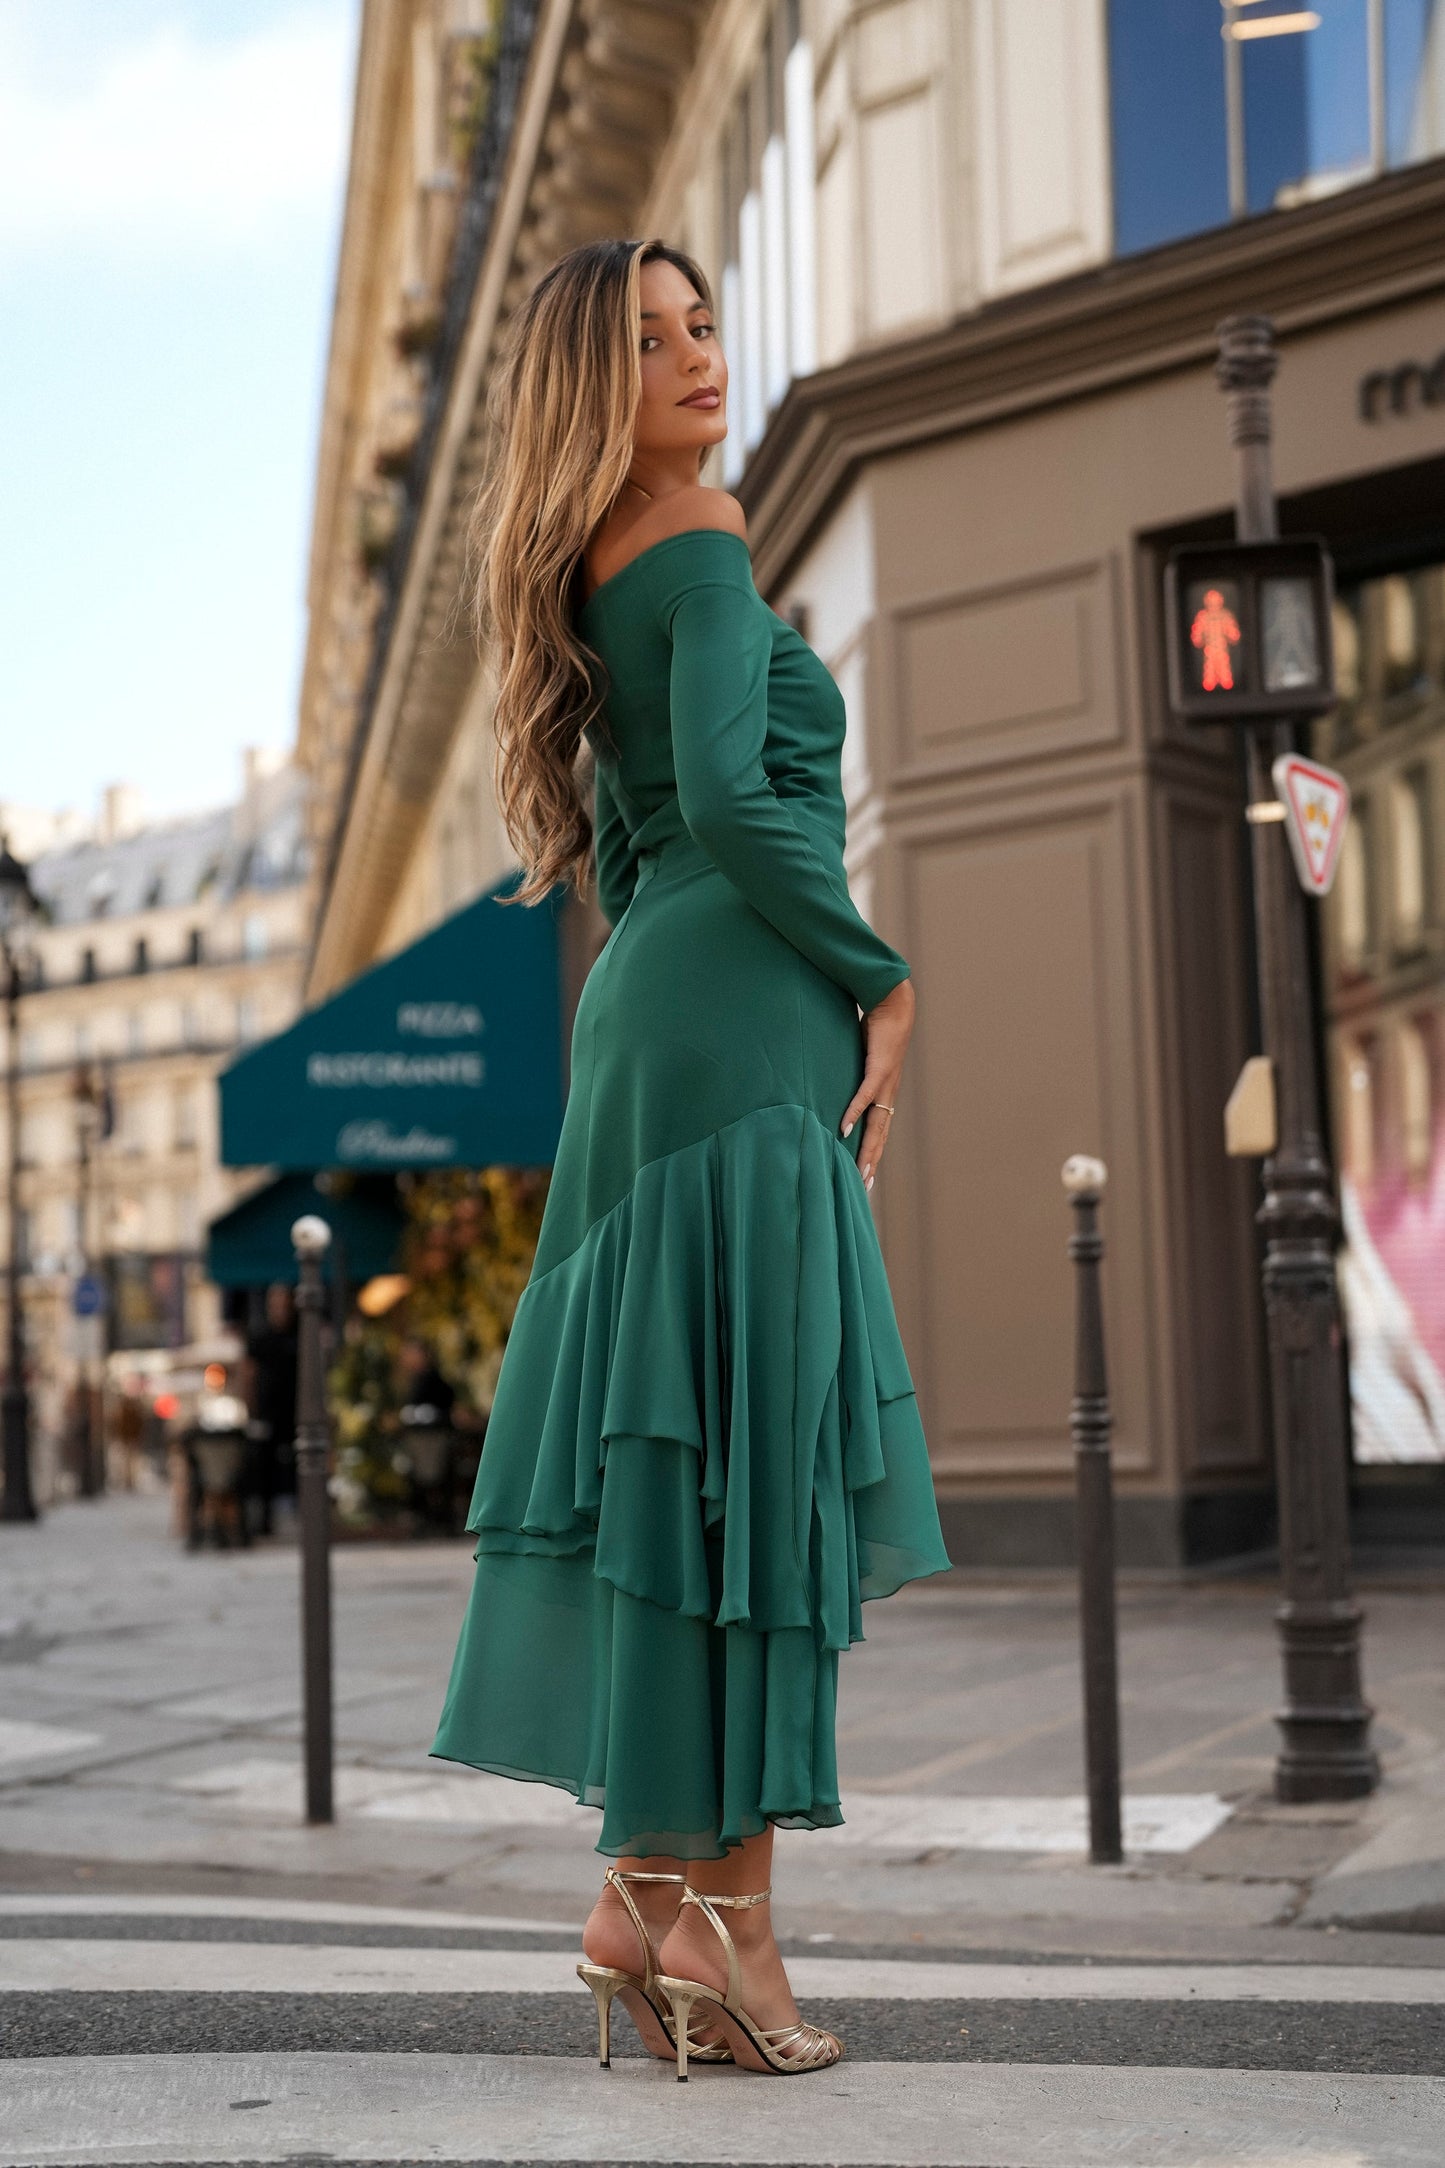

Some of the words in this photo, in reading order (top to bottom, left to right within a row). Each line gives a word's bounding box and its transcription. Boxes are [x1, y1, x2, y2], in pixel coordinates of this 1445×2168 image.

[1359, 349, 1445, 424] m
[398, 1003, 483, 1036] PIZZA
[308, 1053, 484, 1087] RISTORANTE
